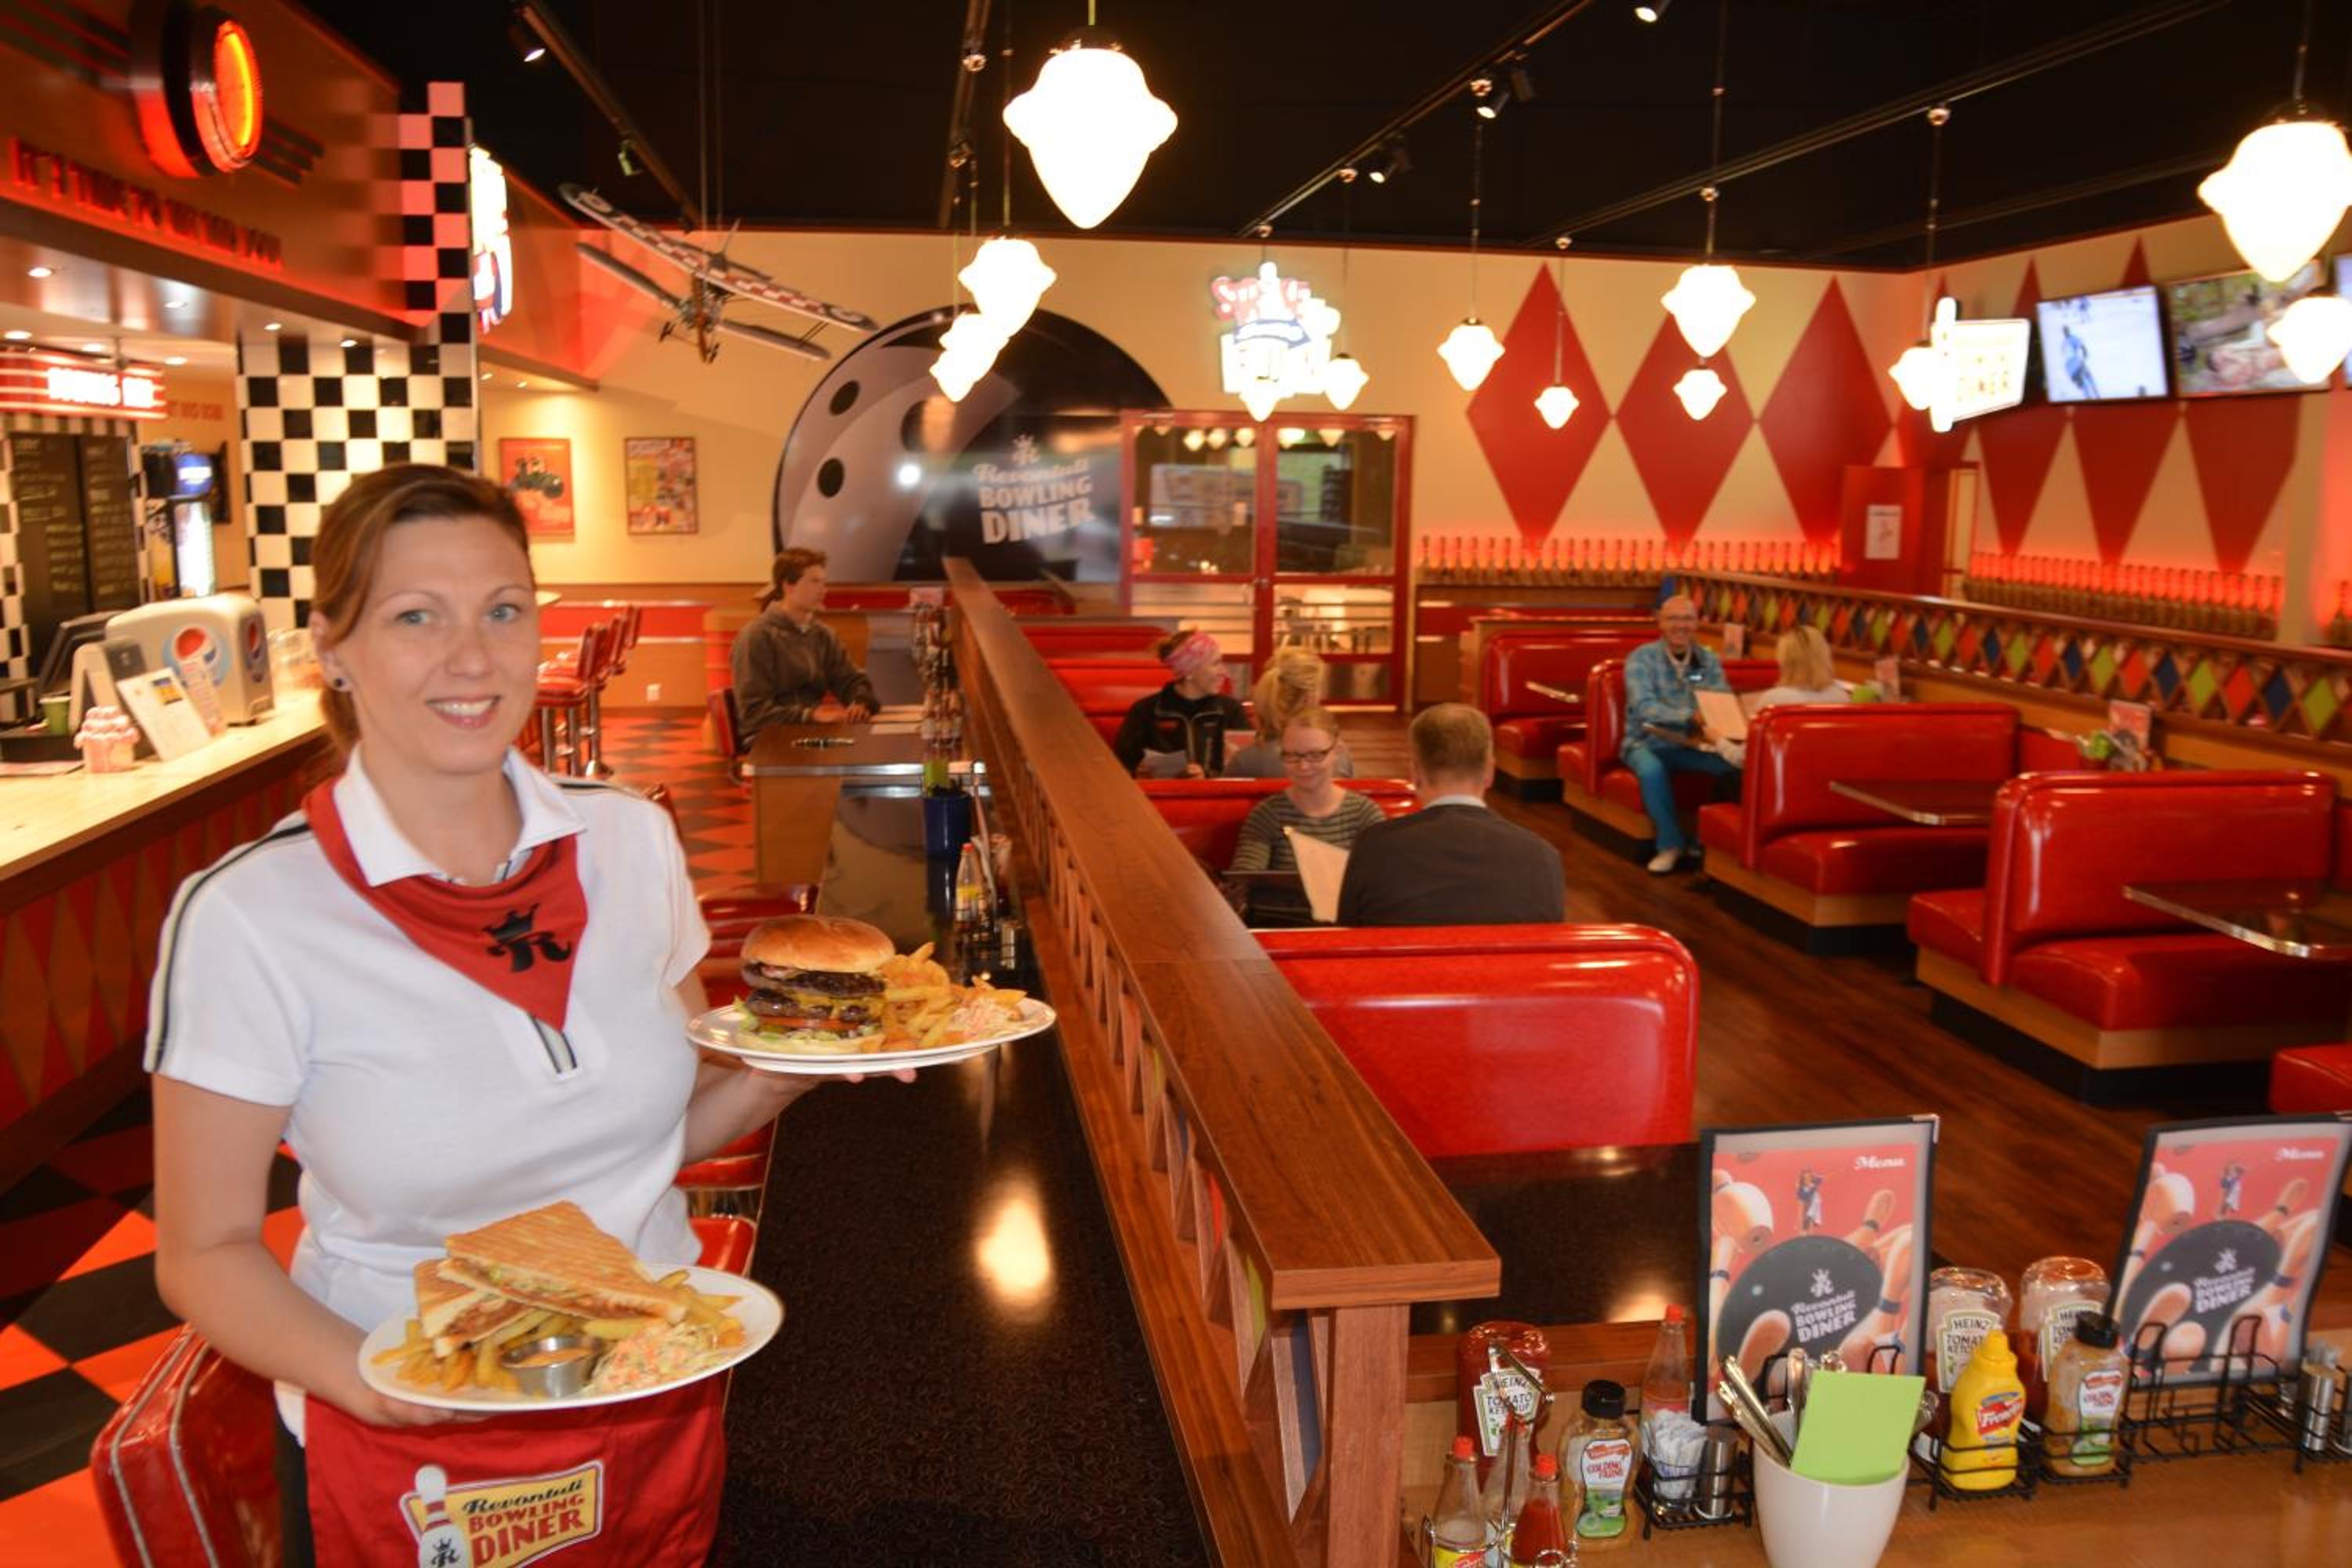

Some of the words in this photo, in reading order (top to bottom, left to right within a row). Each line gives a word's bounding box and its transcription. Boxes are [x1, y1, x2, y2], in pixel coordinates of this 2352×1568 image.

[980, 476, 1092, 509] BOWLING
[981, 497, 1096, 543] DINER
[1854, 1155, 1907, 1171] Menu
[1795, 1300, 1857, 1329] BOWLING
[1798, 1310, 1856, 1343] DINER
[1953, 1316, 1989, 1330] HEINZ
[1947, 1332, 1984, 1346] TOMAT
[469, 1492, 586, 1534] BOWLING
[471, 1508, 585, 1567] DINER
